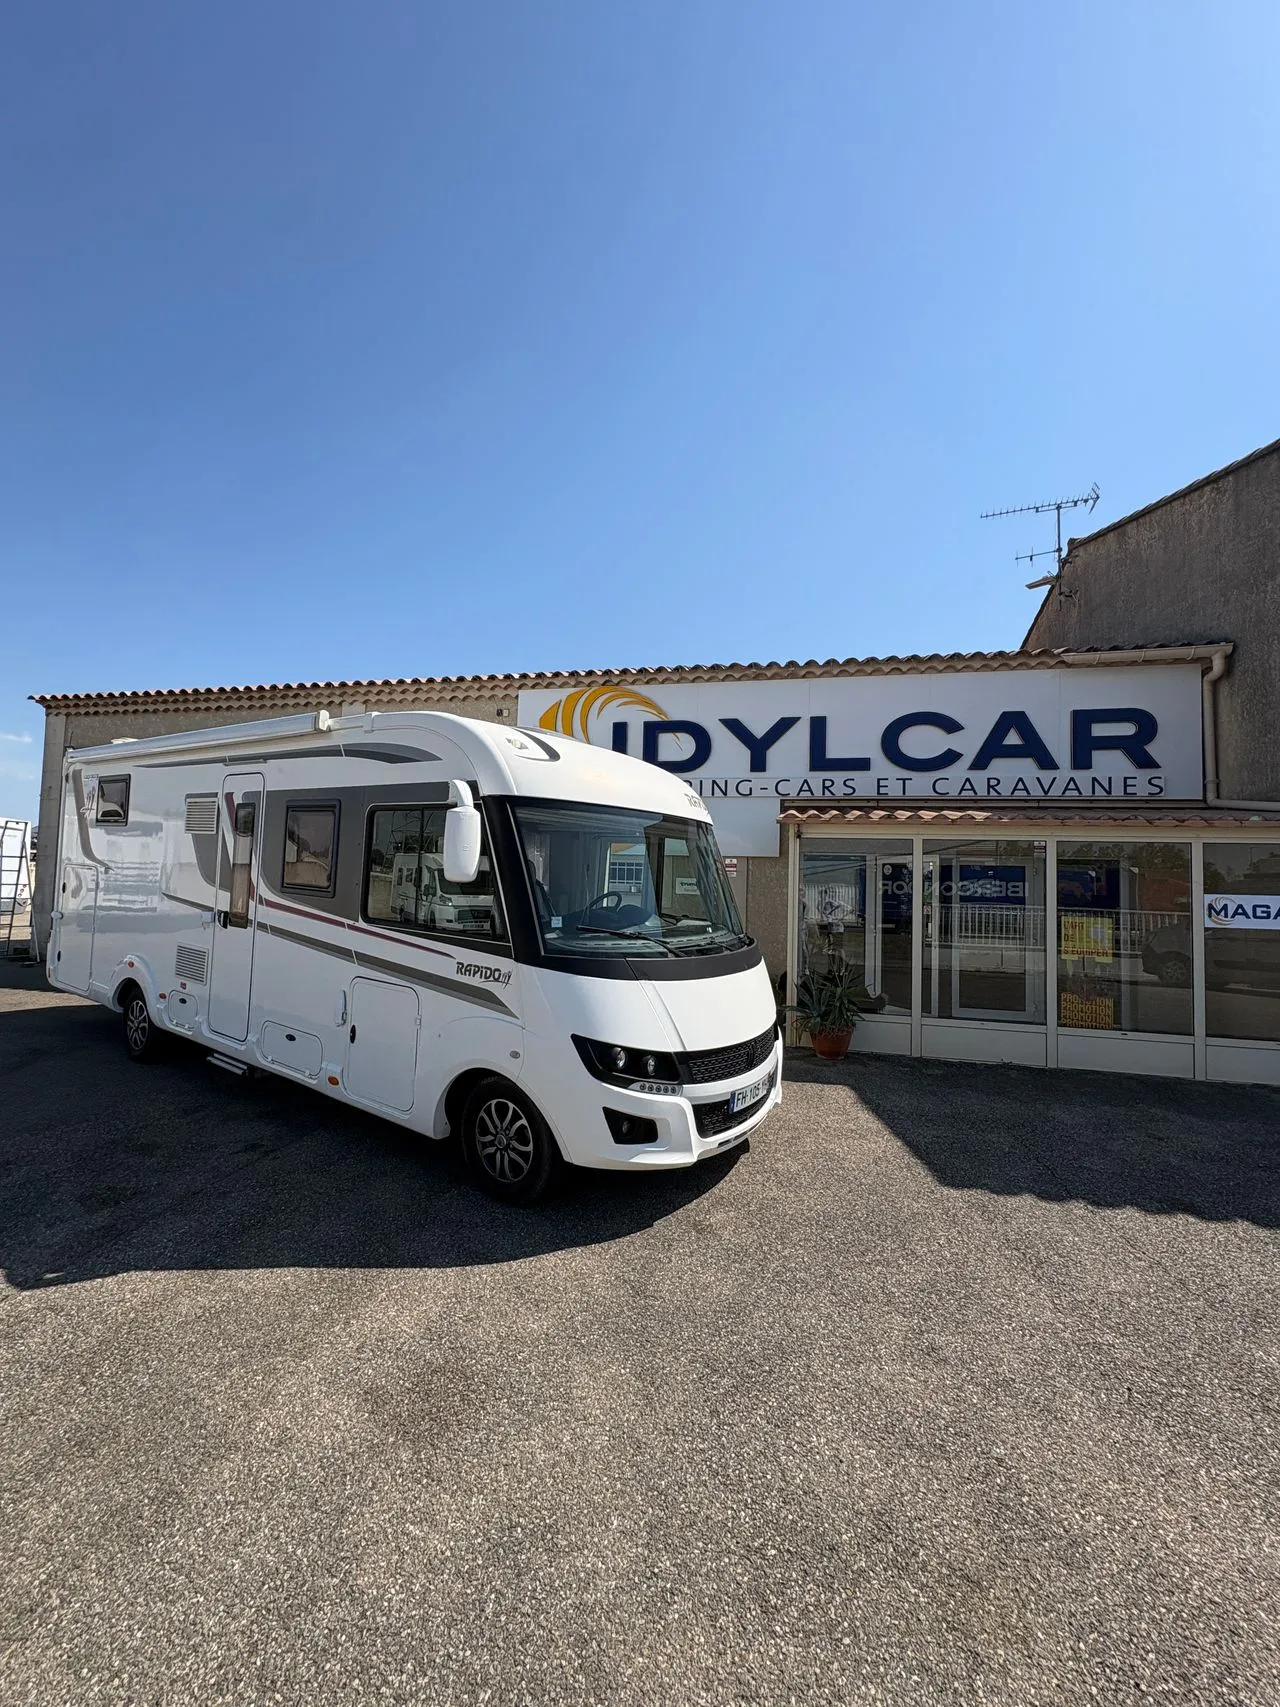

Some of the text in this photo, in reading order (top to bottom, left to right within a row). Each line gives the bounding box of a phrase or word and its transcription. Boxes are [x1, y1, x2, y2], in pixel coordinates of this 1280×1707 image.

[611, 708, 1162, 774] IDYLCAR
[876, 777, 912, 796] ET
[931, 776, 1165, 796] CARAVANES
